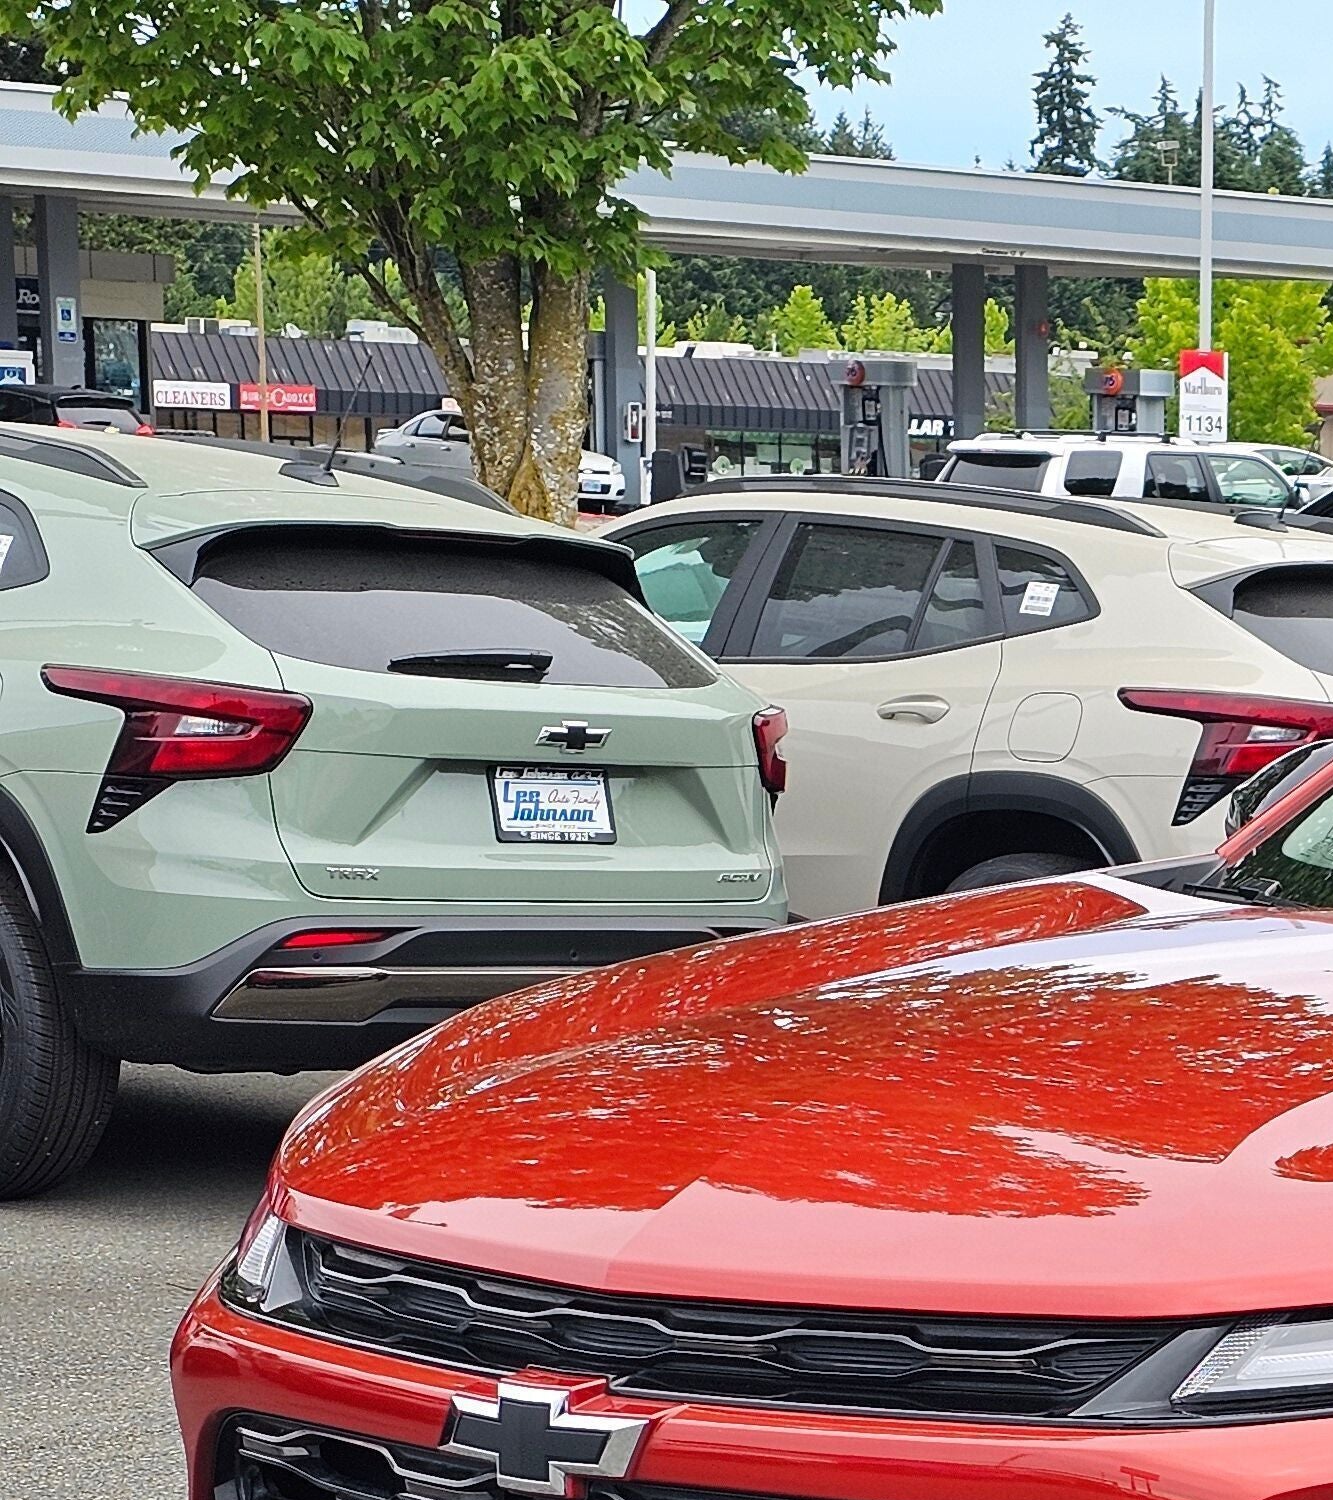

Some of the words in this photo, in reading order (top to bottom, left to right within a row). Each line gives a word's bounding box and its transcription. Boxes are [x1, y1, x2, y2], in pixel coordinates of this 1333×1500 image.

[1184, 377, 1223, 396] Marlboro
[155, 390, 226, 406] CLEANERS
[503, 781, 545, 804] Lee
[547, 789, 570, 804] Auto
[570, 789, 601, 810] Family
[507, 796, 598, 823] Johnson
[530, 832, 561, 841] SINCE
[564, 832, 590, 841] 1933
[325, 866, 380, 881] TRAX
